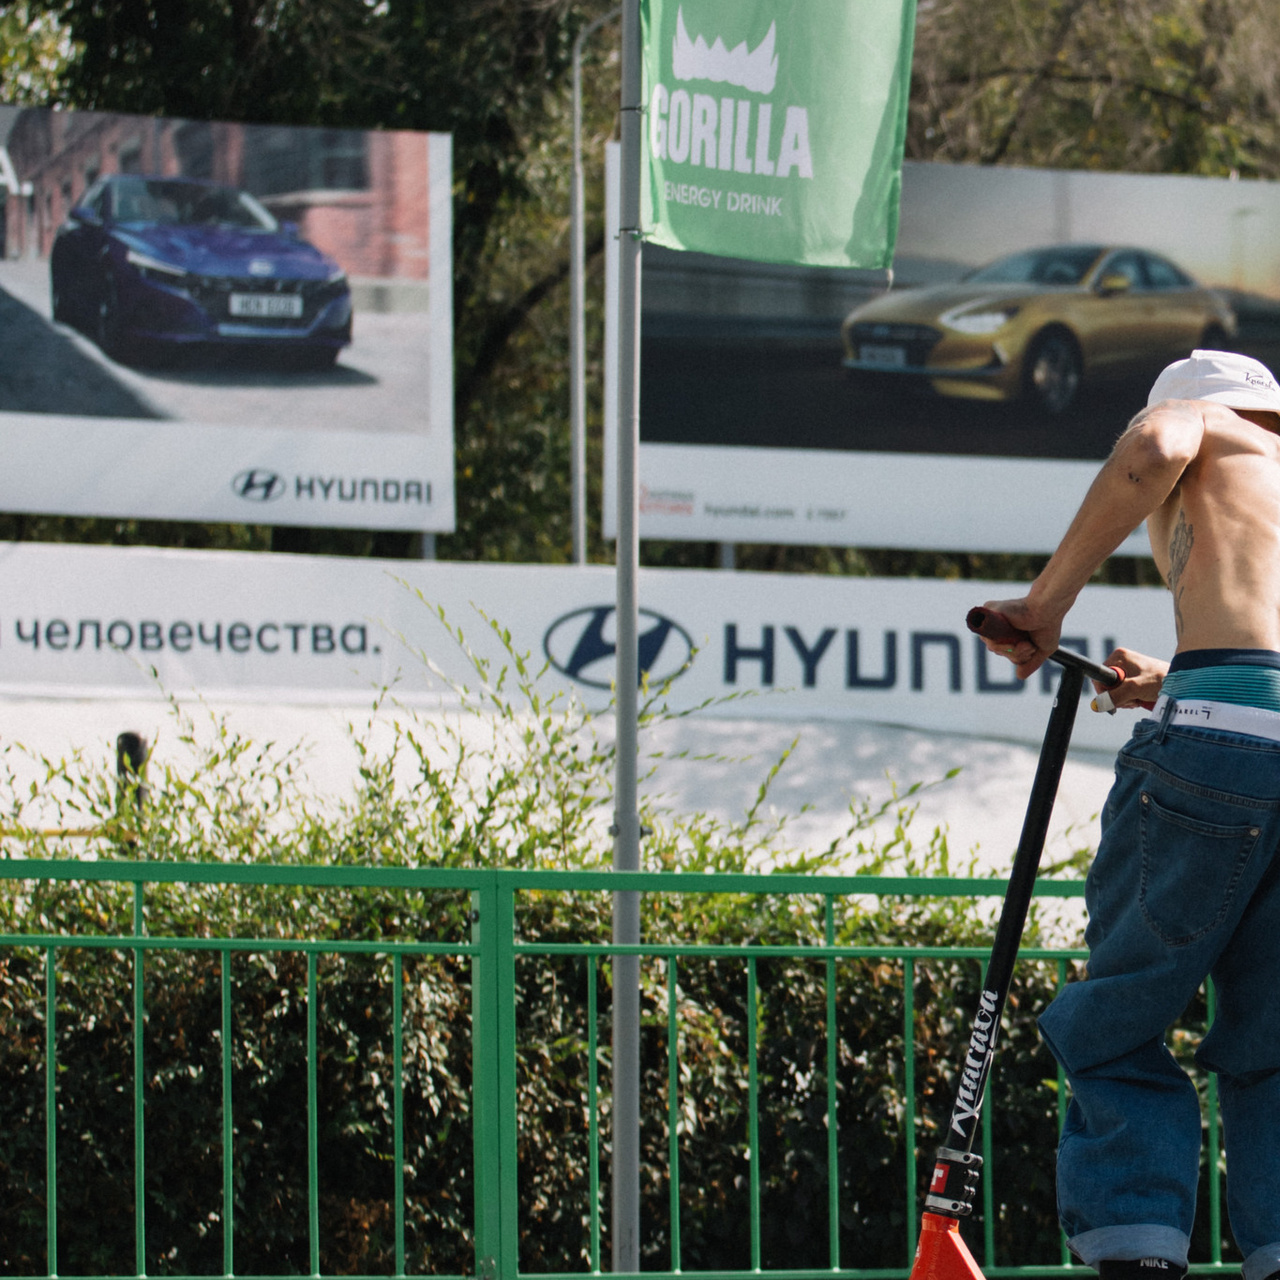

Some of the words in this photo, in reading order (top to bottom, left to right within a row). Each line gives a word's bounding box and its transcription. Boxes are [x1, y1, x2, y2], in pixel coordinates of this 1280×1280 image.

[650, 82, 814, 180] GORILLA
[663, 179, 723, 209] ENERGY
[726, 191, 783, 216] DRINK
[295, 476, 433, 504] HYUNDAI
[15, 618, 382, 655] человечества.
[1140, 1257, 1169, 1270] NIKE
